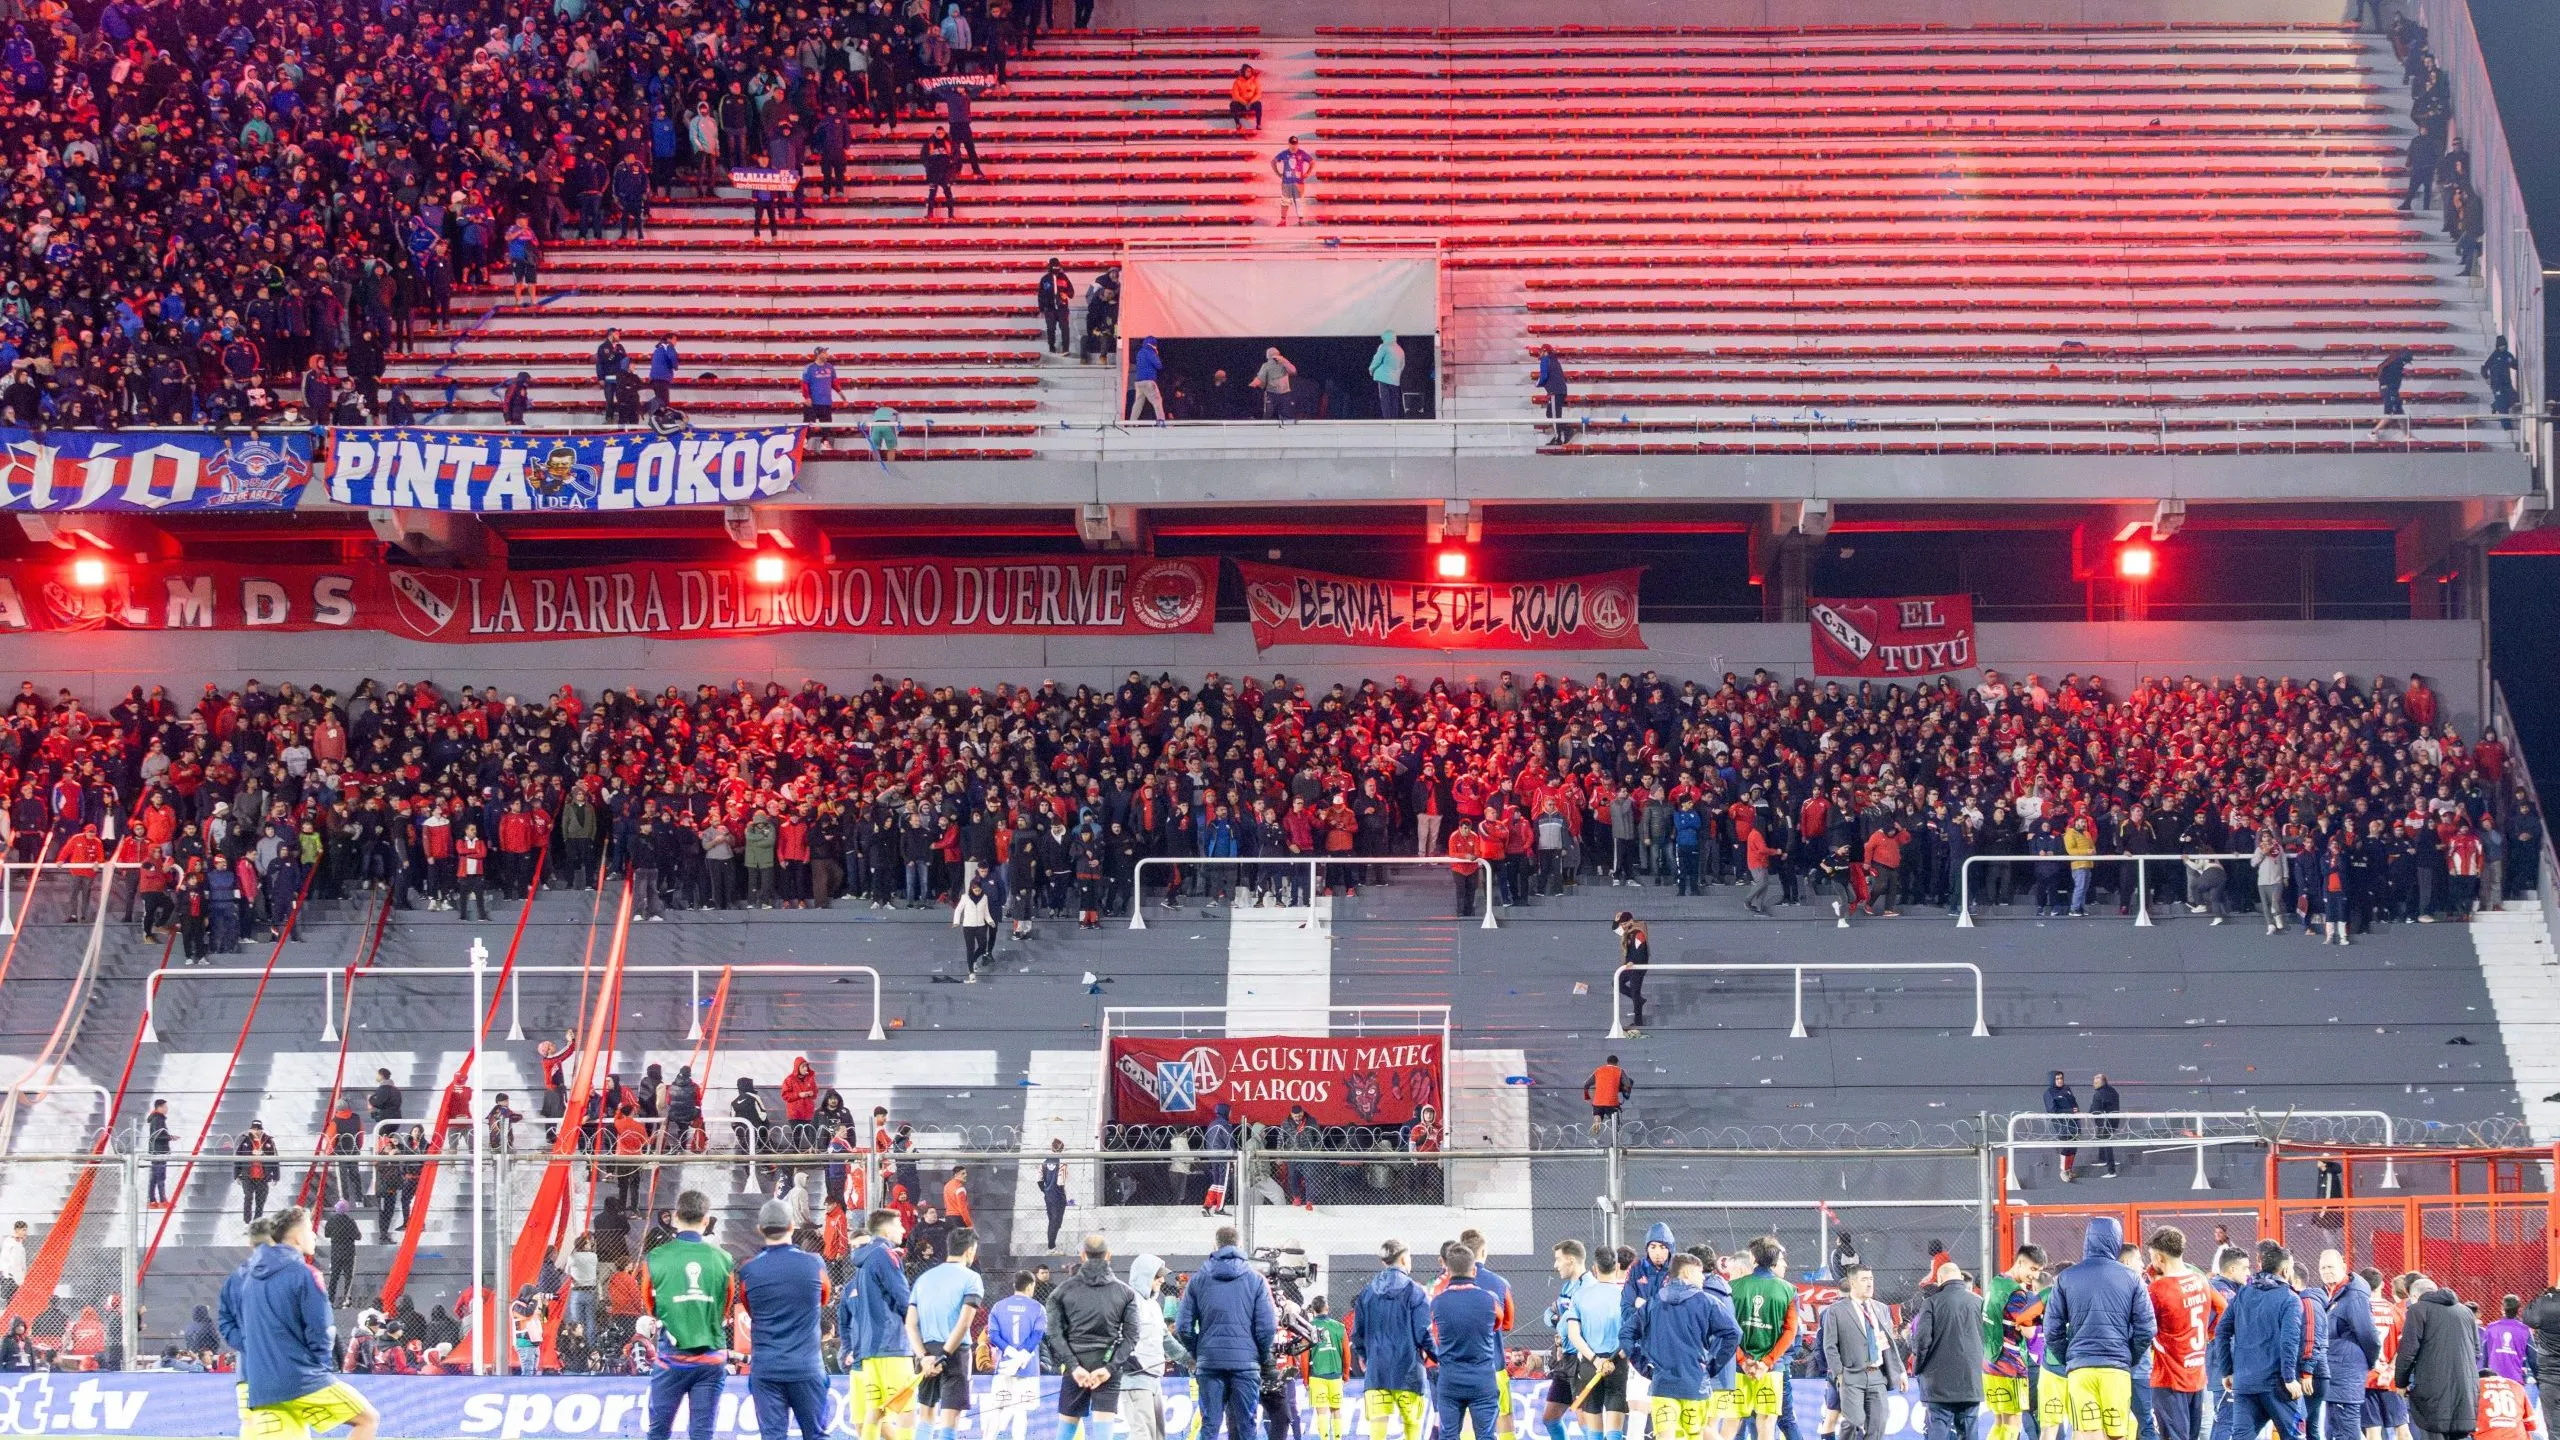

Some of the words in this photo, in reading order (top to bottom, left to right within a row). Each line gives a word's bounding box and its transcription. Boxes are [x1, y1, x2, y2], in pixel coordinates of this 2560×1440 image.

[332, 440, 528, 511] PINTA
[599, 433, 796, 510] LOKOS
[468, 576, 524, 633] LA
[531, 570, 673, 633] BARRA
[677, 568, 762, 631] DEL
[881, 564, 942, 626] NO
[951, 564, 1127, 627] DUERME
[1297, 577, 1405, 638] BERNAL
[1411, 585, 1443, 636] ES
[1451, 584, 1503, 634] DEL
[1510, 582, 1580, 641] ROJO
[1900, 601, 1945, 628] EL
[1879, 630, 1970, 671] TUYÚ
[1230, 1046, 1347, 1073] AGUSTIN
[1230, 1079, 1331, 1103] MARCOS
[1012, 1315, 1020, 1345] 1
[2190, 1306, 2205, 1351] 5
[2483, 1389, 2517, 1418] 36
